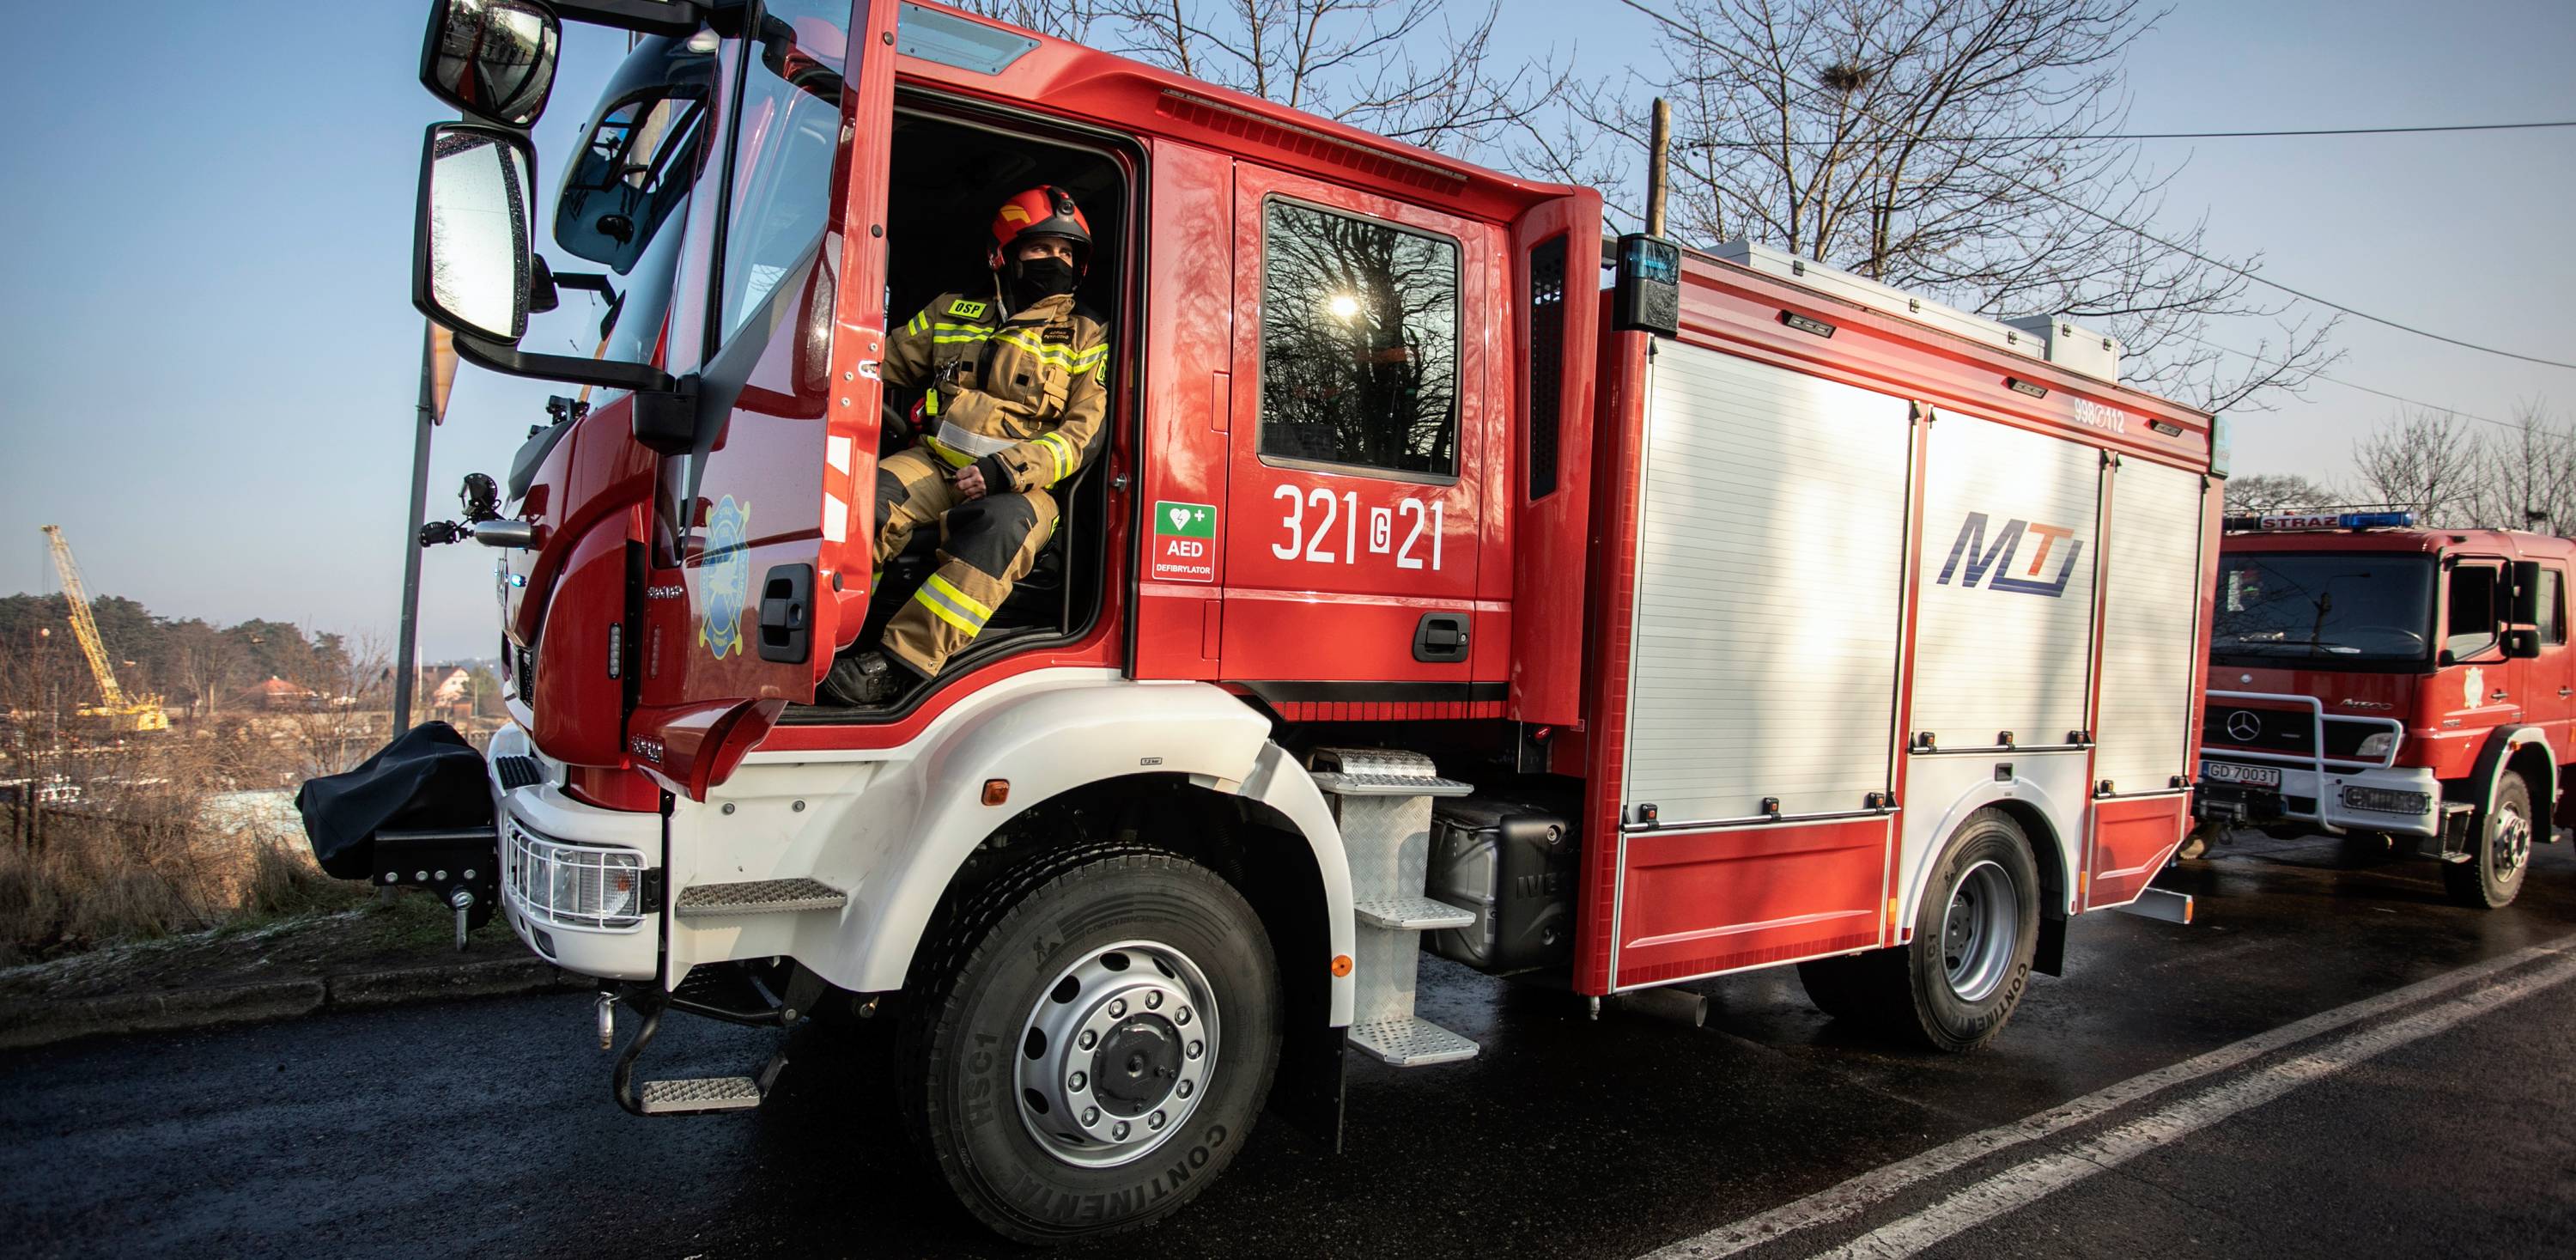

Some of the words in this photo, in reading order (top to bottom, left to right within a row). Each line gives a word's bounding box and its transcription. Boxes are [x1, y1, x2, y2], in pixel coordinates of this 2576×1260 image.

[954, 302, 981, 314] OSP
[2074, 397, 2095, 426] 998
[2105, 407, 2124, 434] 112
[1271, 484, 1358, 564] 321
[1373, 512, 1388, 549] G
[1396, 497, 1443, 570] 21
[1166, 539, 1204, 557] AED
[1156, 563, 1211, 575] DEFIBRYLATOR
[2210, 764, 2230, 777] GD
[2234, 767, 2277, 782] 7003T
[1516, 872, 1566, 901] IVE
[965, 1032, 999, 1129] HSC1
[1002, 1123, 1228, 1220] CONTINENTAL
